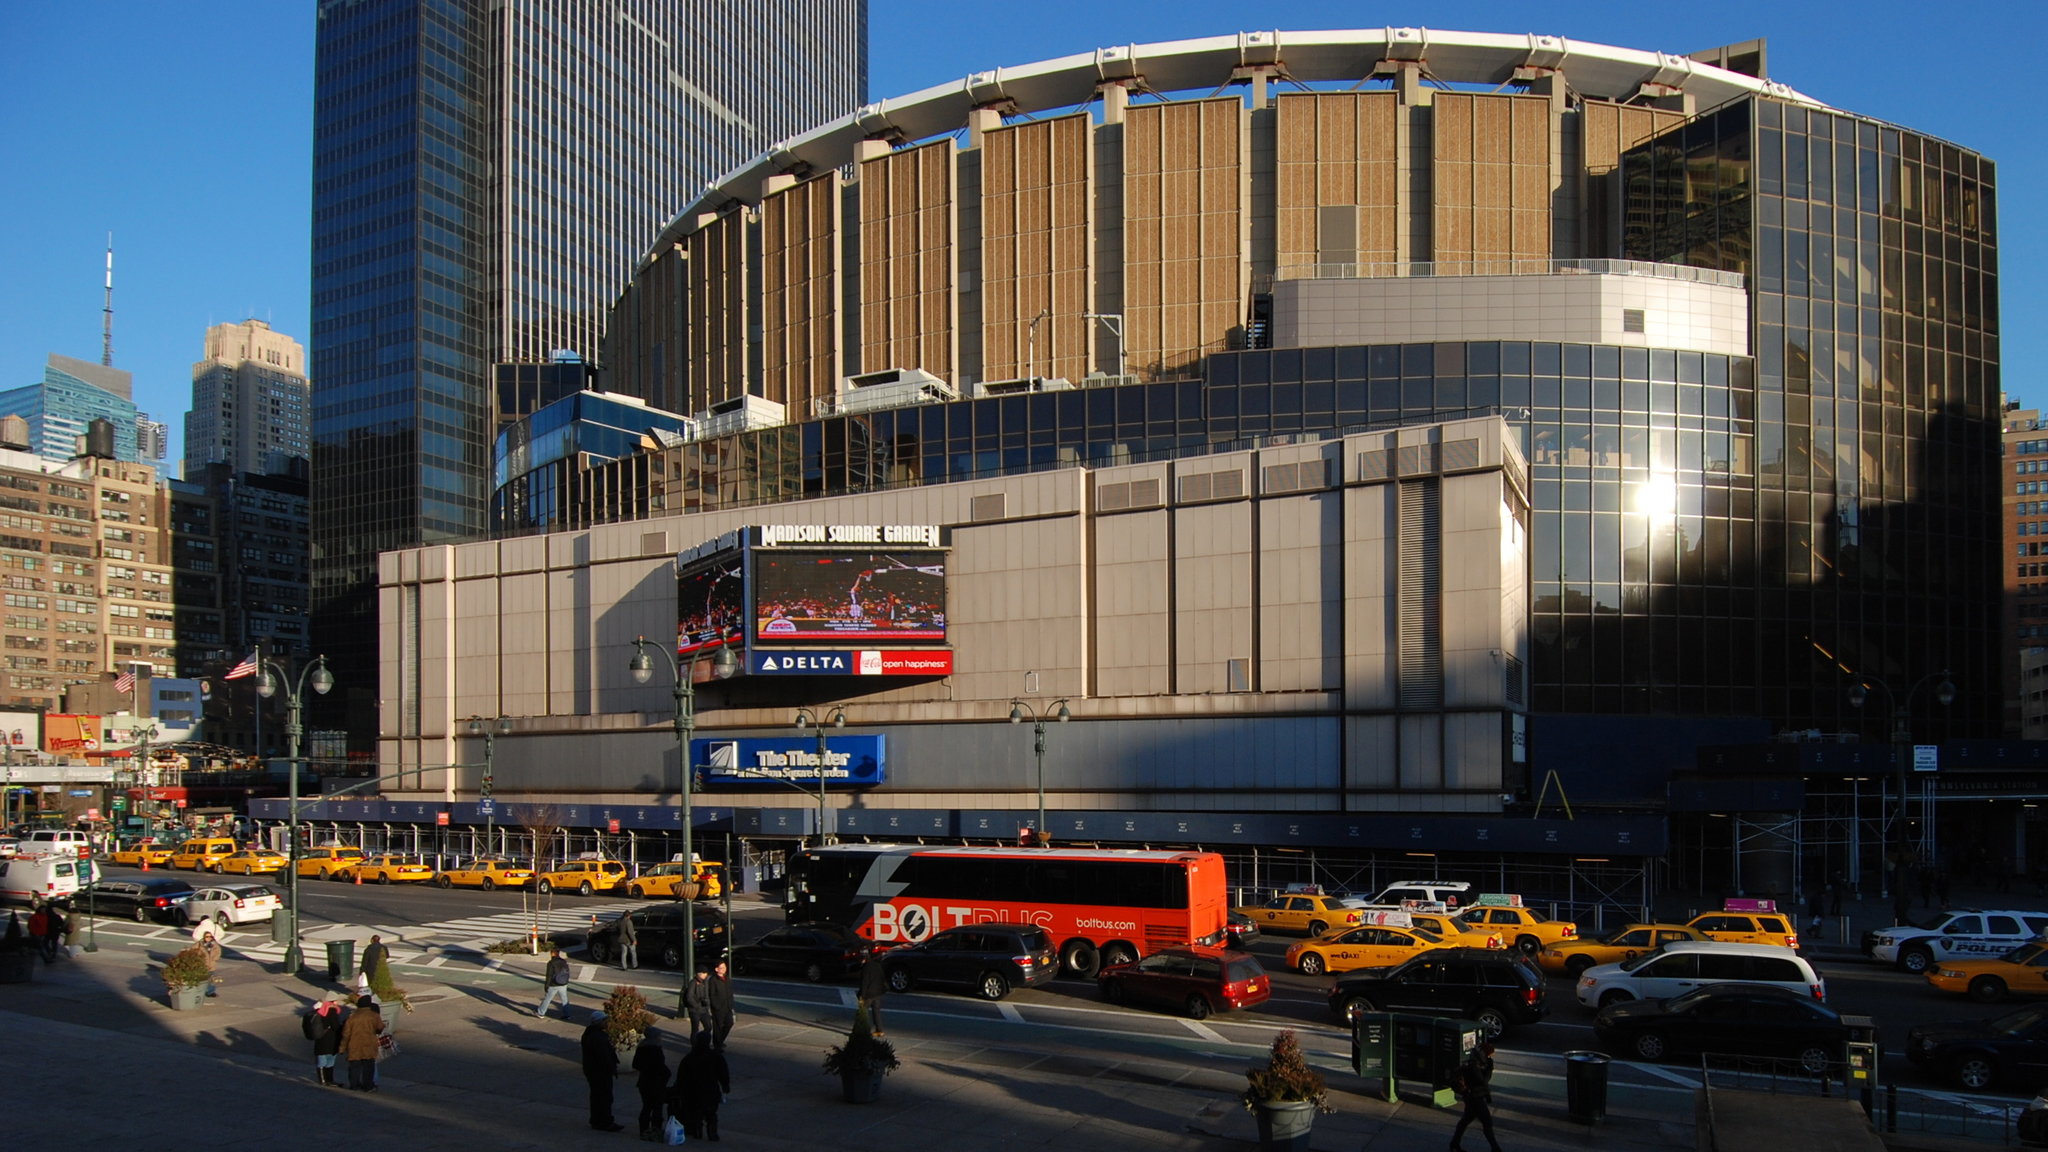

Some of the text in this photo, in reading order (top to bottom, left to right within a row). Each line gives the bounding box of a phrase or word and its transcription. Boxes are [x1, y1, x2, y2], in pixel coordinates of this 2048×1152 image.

[761, 525, 940, 547] MADISON SQUARE GARDEN
[782, 656, 844, 669] DELTA
[882, 660, 904, 669] open
[905, 660, 945, 669] happiness
[756, 750, 788, 767] The
[782, 767, 813, 781] Square
[1076, 917, 1136, 930] boltbus.com
[1955, 944, 2017, 953] POLICE
